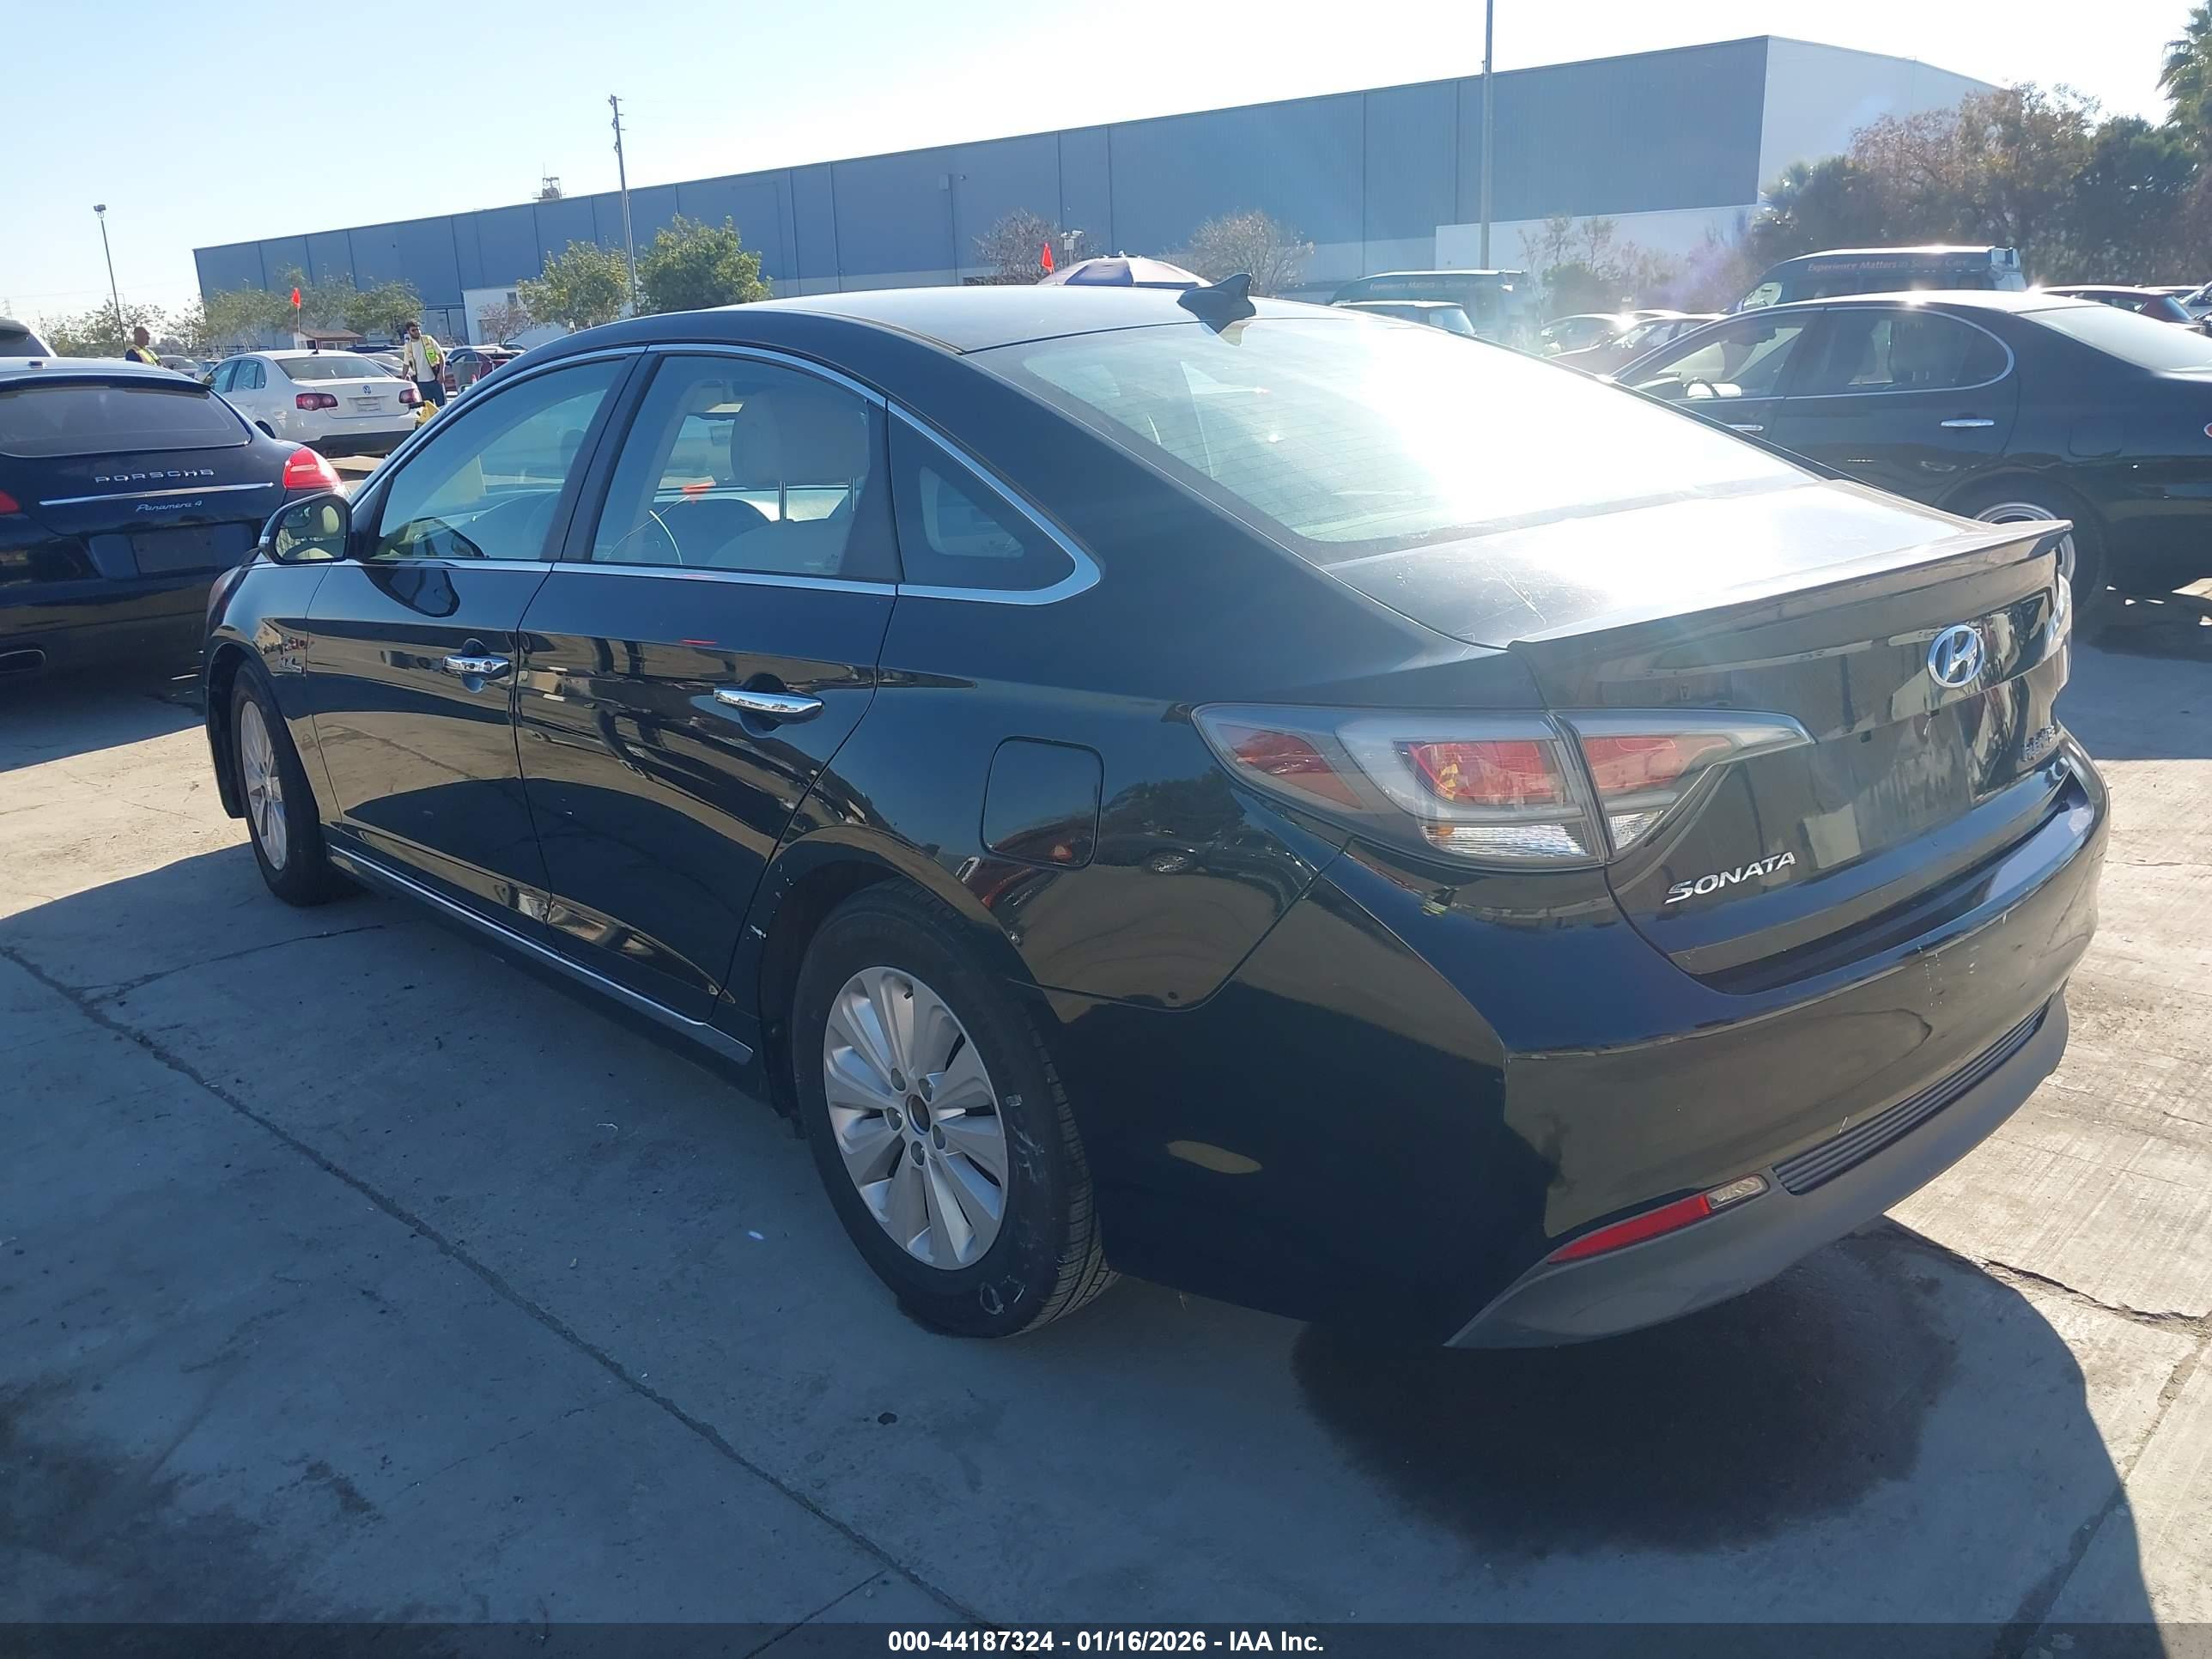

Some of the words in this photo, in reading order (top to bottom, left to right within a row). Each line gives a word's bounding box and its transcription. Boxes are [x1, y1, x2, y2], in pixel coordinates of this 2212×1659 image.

[1808, 263, 1856, 272] Experience
[1860, 260, 1897, 269] Matters
[95, 470, 215, 483] PORSCHE
[136, 501, 192, 513] Panamera
[1664, 851, 1796, 904] SONATA
